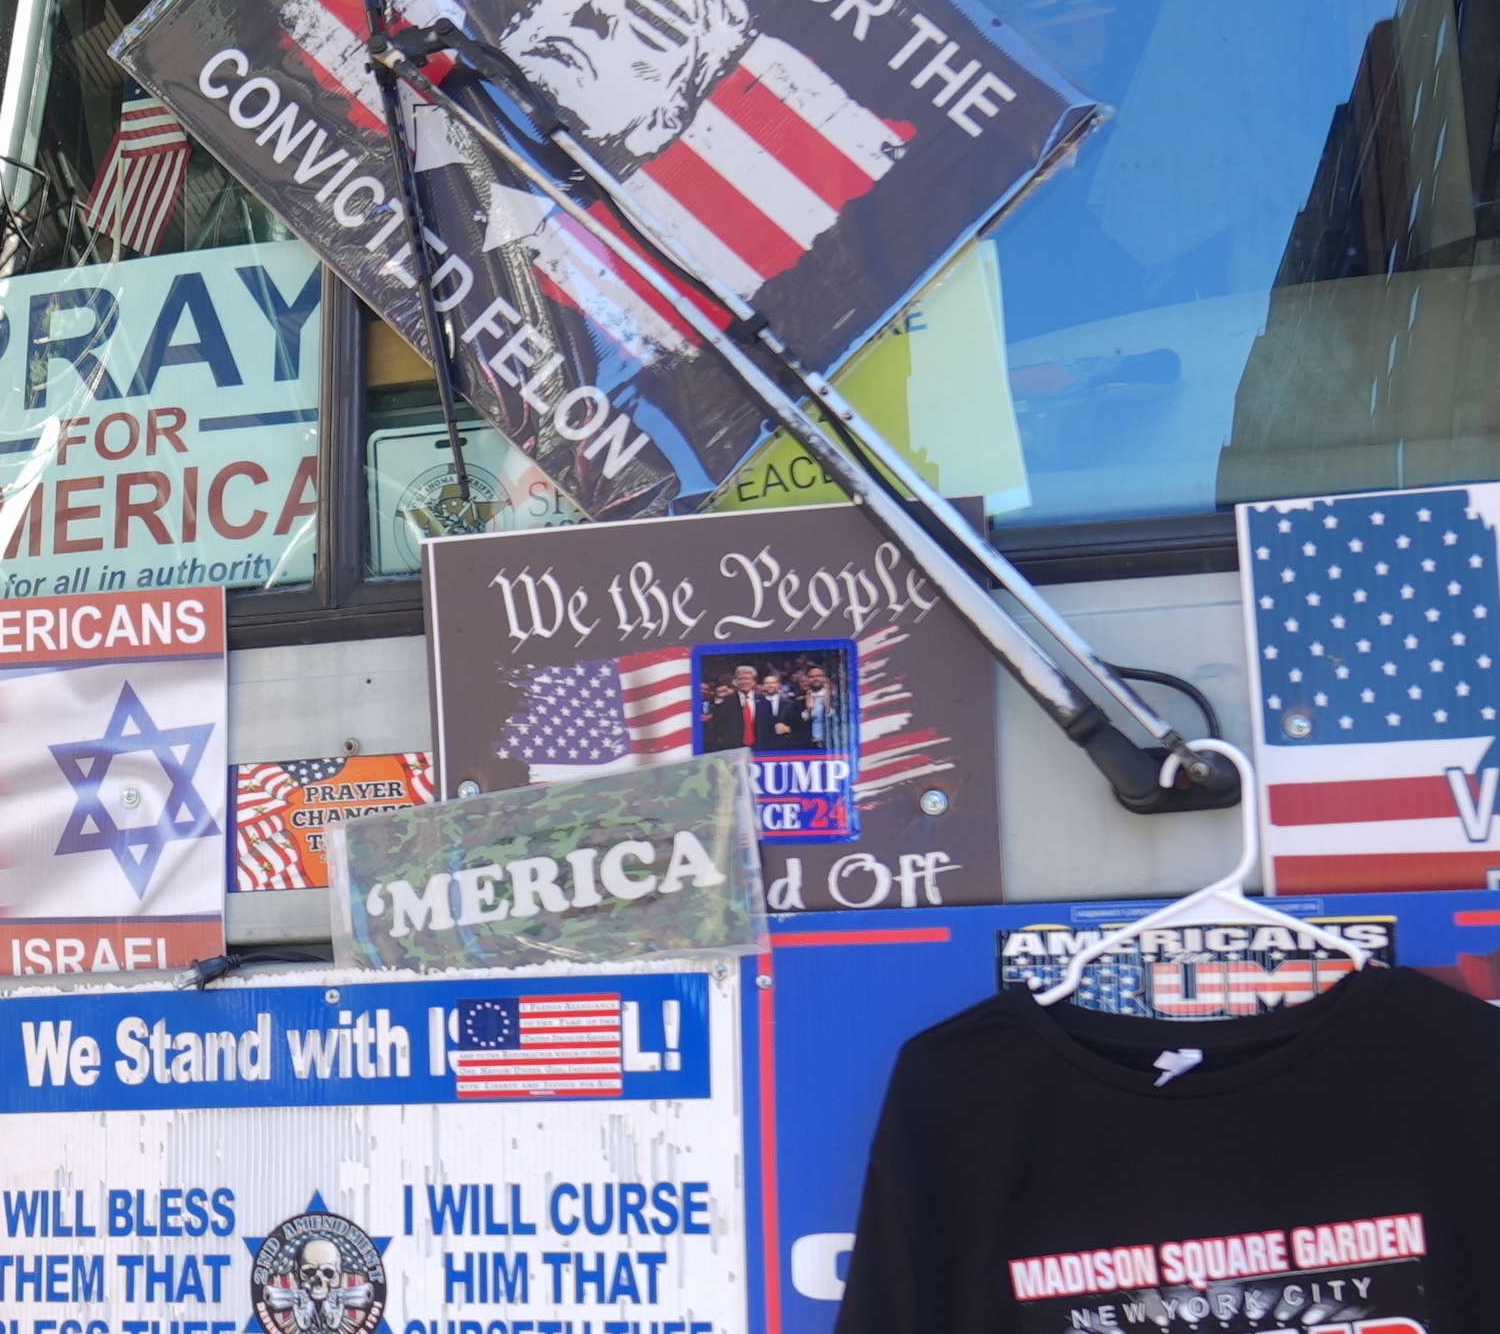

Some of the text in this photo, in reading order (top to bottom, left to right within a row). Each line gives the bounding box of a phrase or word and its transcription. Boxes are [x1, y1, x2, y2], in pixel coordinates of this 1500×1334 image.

[886, 15, 1018, 138] THE
[196, 47, 653, 478] CONVICTED FELON
[56, 407, 189, 466] FOR
[53, 566, 90, 592] all
[97, 566, 125, 589] in
[136, 554, 288, 592] authority.
[490, 541, 940, 653] We the People
[304, 782, 403, 804] PRAYER
[366, 830, 725, 937] 'MERICA
[828, 851, 962, 908] Off
[12, 937, 168, 980] ISRAEL
[1003, 924, 1389, 956] AMERICANS
[21, 1020, 102, 1088] We
[115, 1014, 271, 1086] Stand
[288, 1009, 412, 1082] with
[4, 1191, 95, 1238] WILL
[108, 1188, 236, 1238] BLESS
[404, 1181, 711, 1237] I WILL CURSE
[254, 1215, 384, 1285] 2ND AMENDMENT
[445, 1251, 667, 1304] HIM THAT
[1009, 1213, 1427, 1301] MADISON SQUARE GARDEN
[122, 1253, 227, 1305] THAT
[1071, 1277, 1372, 1330] NEW YORK CITY
